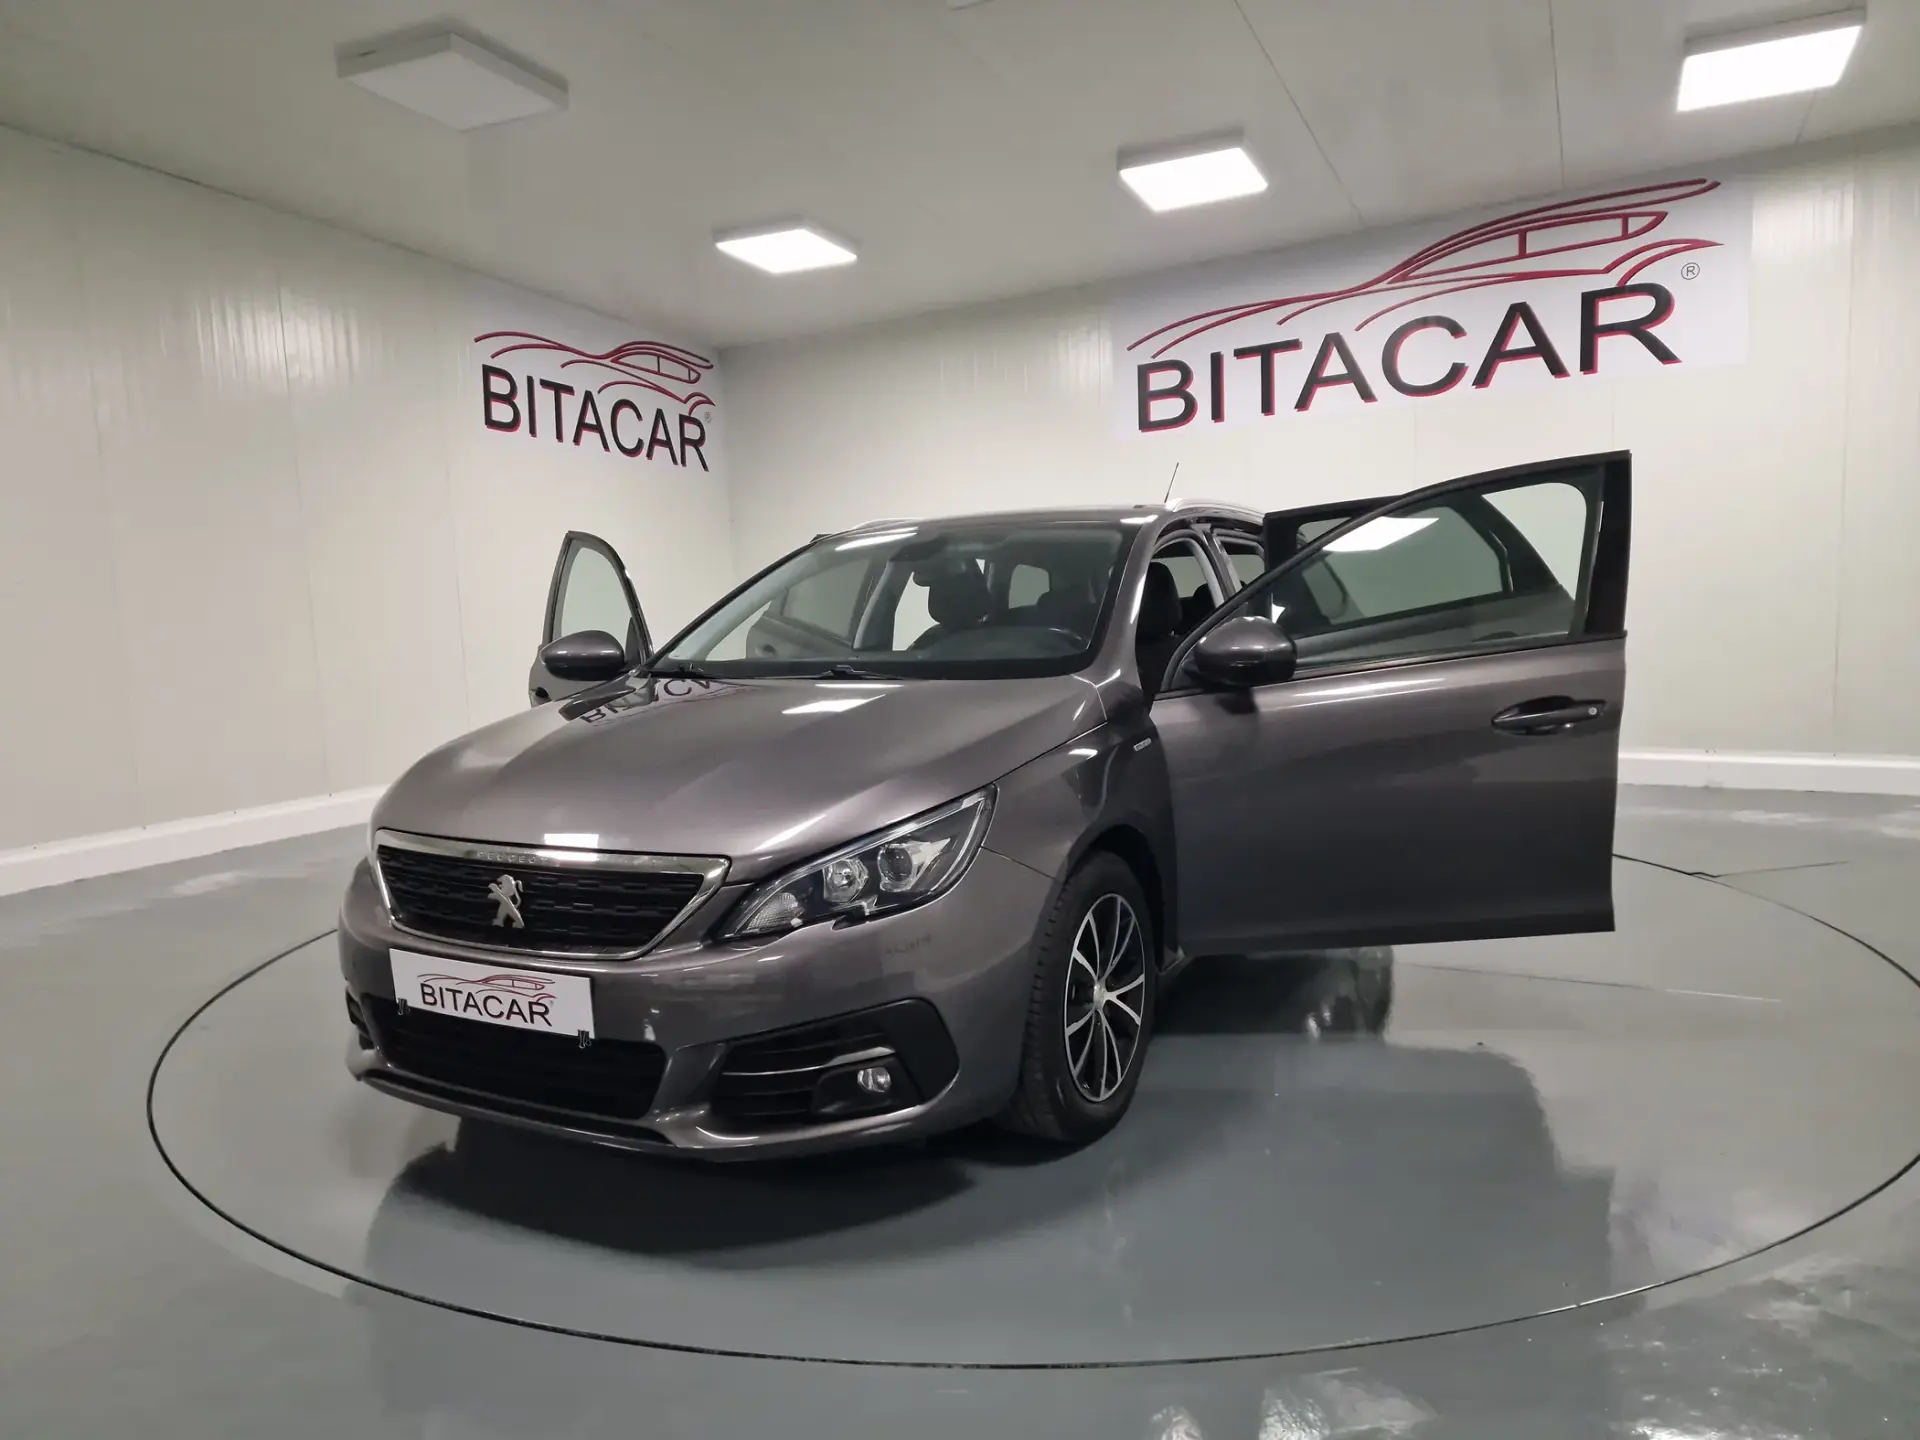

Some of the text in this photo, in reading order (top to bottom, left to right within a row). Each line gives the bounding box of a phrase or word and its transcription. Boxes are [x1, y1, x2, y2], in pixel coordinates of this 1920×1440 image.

[1137, 282, 1682, 433] BITACAR
[482, 363, 709, 472] BITACAR
[420, 983, 552, 1027] BITACAR
